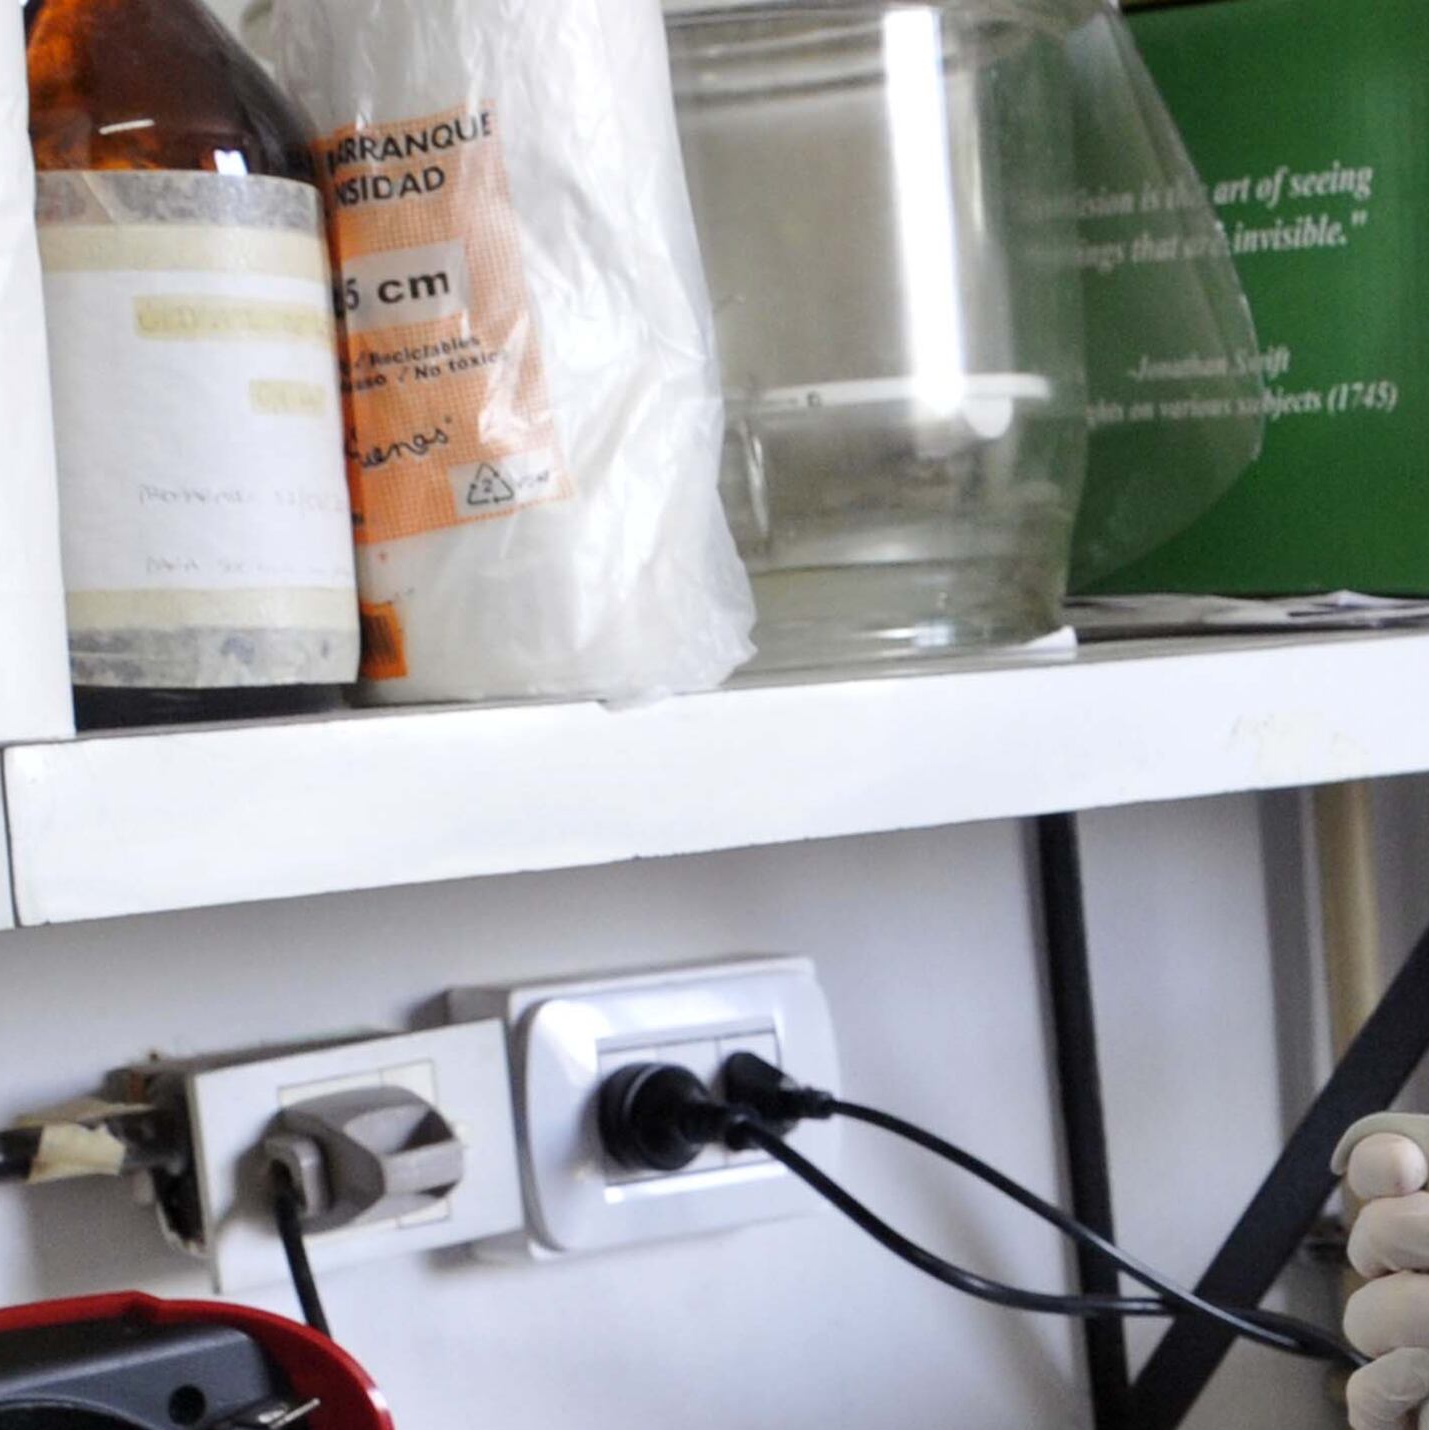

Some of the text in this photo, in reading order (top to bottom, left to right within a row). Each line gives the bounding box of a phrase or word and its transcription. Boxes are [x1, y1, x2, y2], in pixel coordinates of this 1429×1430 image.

[1213, 175, 1251, 205] art
[1255, 165, 1289, 210] of
[1288, 160, 1374, 201] seeing
[378, 270, 449, 304] cm
[414, 365, 441, 380] No
